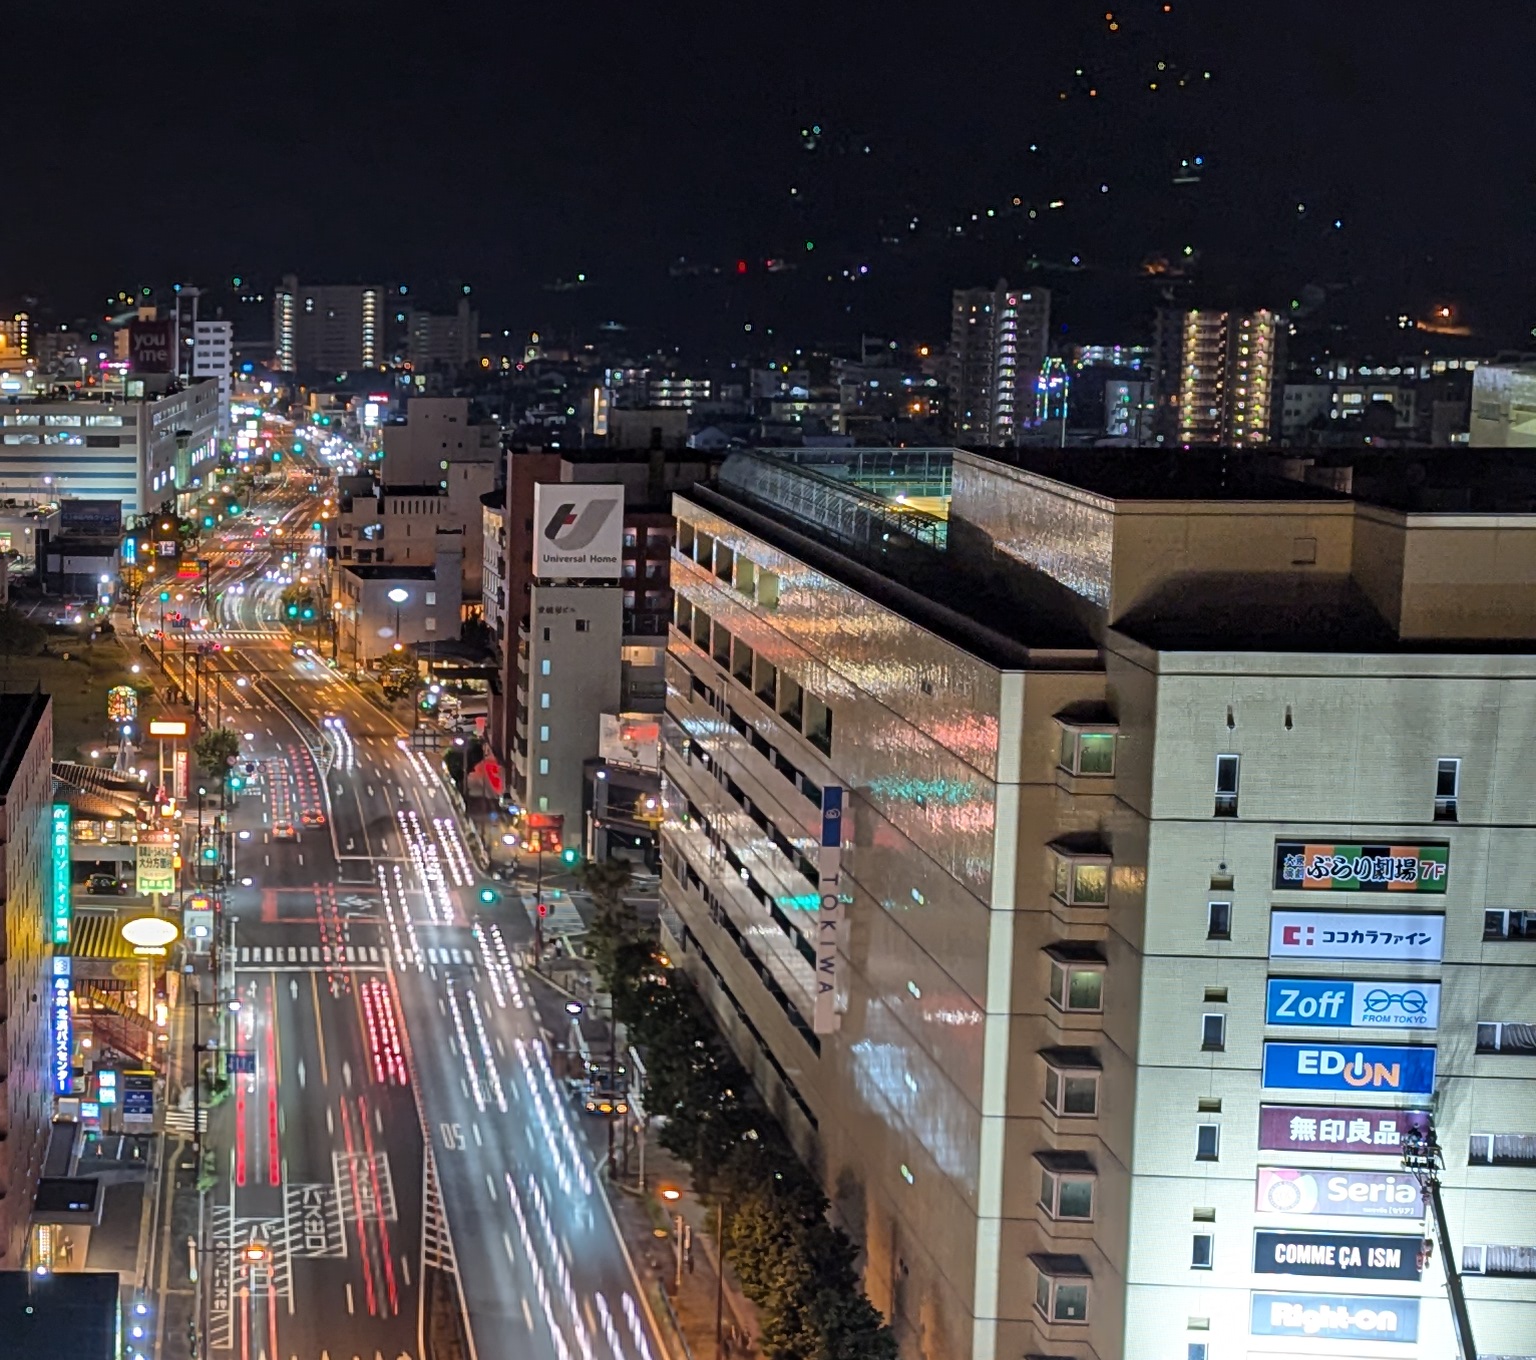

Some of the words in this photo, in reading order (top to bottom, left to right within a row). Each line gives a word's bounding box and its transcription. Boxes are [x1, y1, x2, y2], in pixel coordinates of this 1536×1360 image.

[134, 332, 165, 351] you
[139, 349, 168, 361] me
[543, 554, 586, 563] Universal
[590, 554, 617, 563] Home
[1306, 854, 1418, 882] ぶらり劇場
[1420, 859, 1446, 881] 7F
[818, 873, 839, 995] TOKIWA
[1322, 929, 1432, 945] ココカラファイン
[1276, 989, 1346, 1018] Zoff
[1362, 1014, 1391, 1023] FROM
[1394, 1014, 1427, 1024] TOKYO
[1297, 1049, 1401, 1088] EDION
[1289, 1115, 1401, 1145] 無印良品
[1327, 1176, 1417, 1204] Seria
[1275, 1243, 1336, 1266] COMME
[1339, 1246, 1362, 1269] ÇA
[1367, 1247, 1402, 1268] ISM
[1270, 1301, 1398, 1334] Right-on
